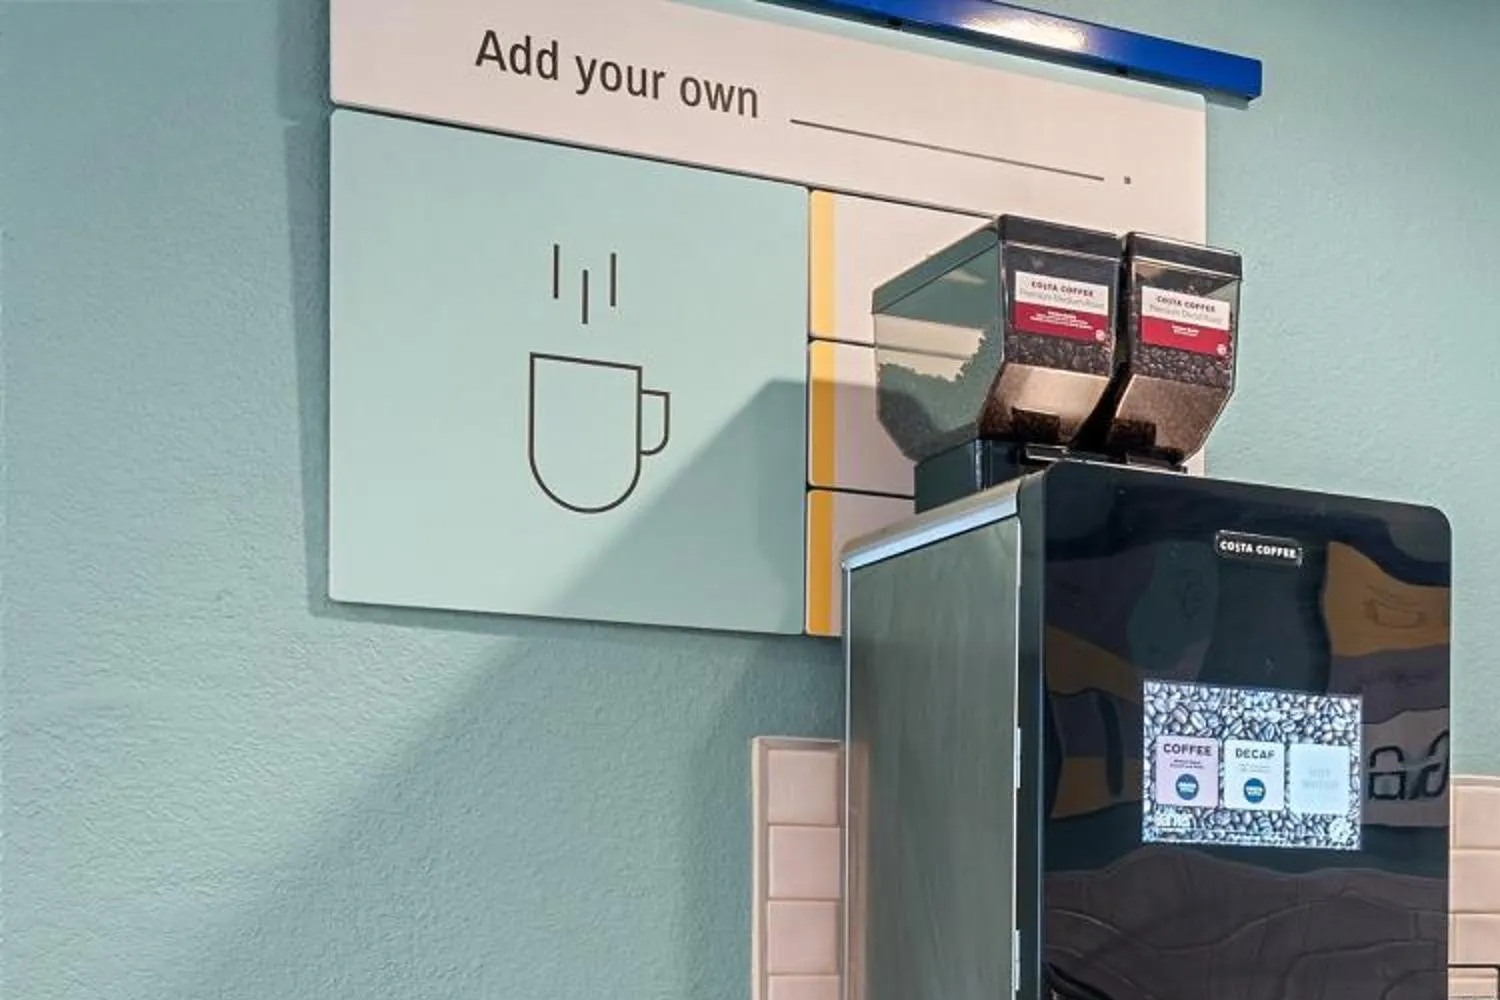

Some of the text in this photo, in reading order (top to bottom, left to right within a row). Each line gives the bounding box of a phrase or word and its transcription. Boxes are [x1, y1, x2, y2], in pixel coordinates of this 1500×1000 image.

[475, 29, 758, 118] Add your own
[1031, 281, 1094, 298] COSTA COFFEE
[1157, 295, 1216, 313] COSTA COFFEE
[1220, 540, 1297, 559] COSTA COFFEE
[1163, 743, 1213, 757] COFFEE
[1235, 747, 1275, 760] DECAF
